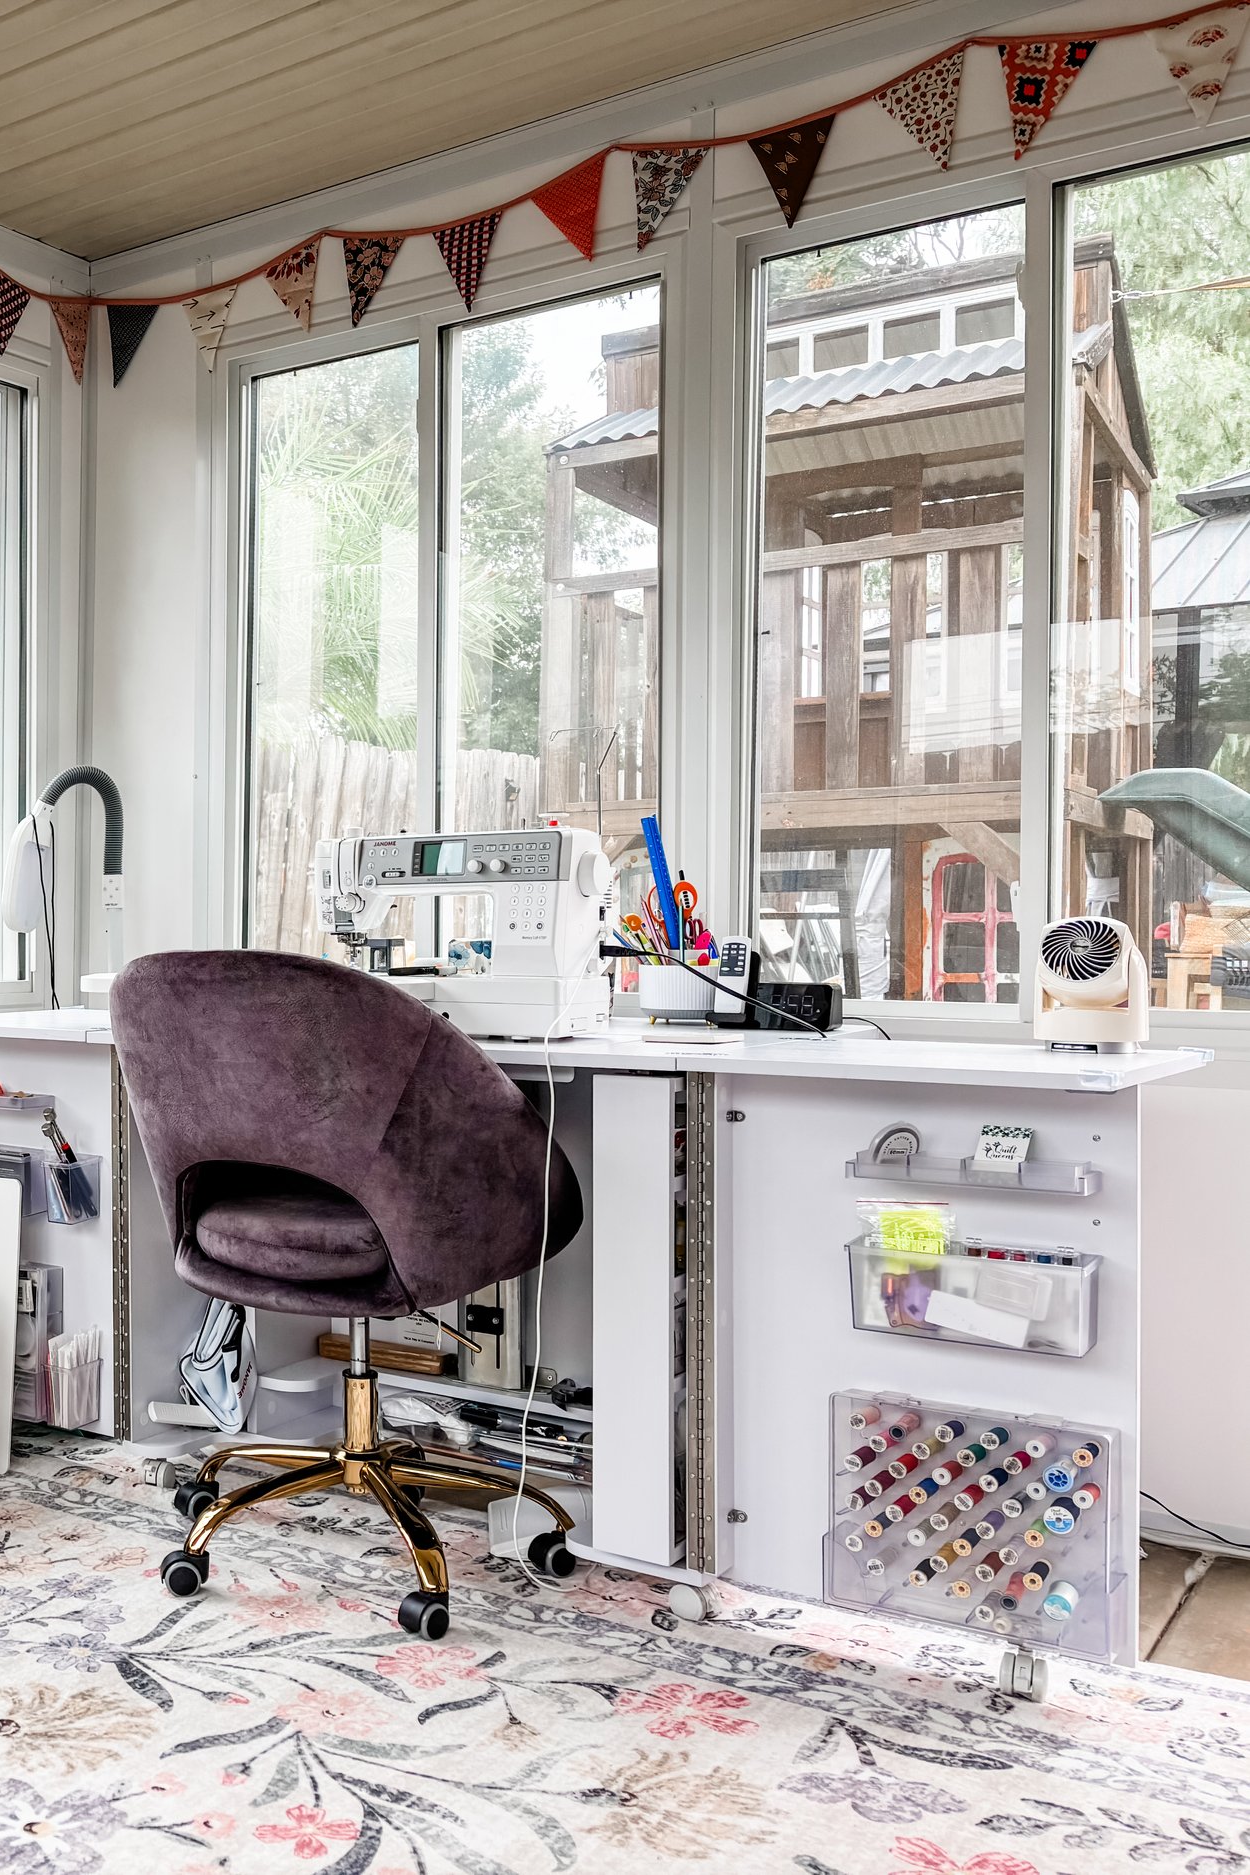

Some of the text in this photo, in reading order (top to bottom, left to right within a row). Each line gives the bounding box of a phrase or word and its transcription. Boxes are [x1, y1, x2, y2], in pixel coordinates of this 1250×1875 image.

[996, 1144, 1017, 1154] Quilt
[986, 1150, 1015, 1160] Queens
[237, 1361, 252, 1399] JANOME
